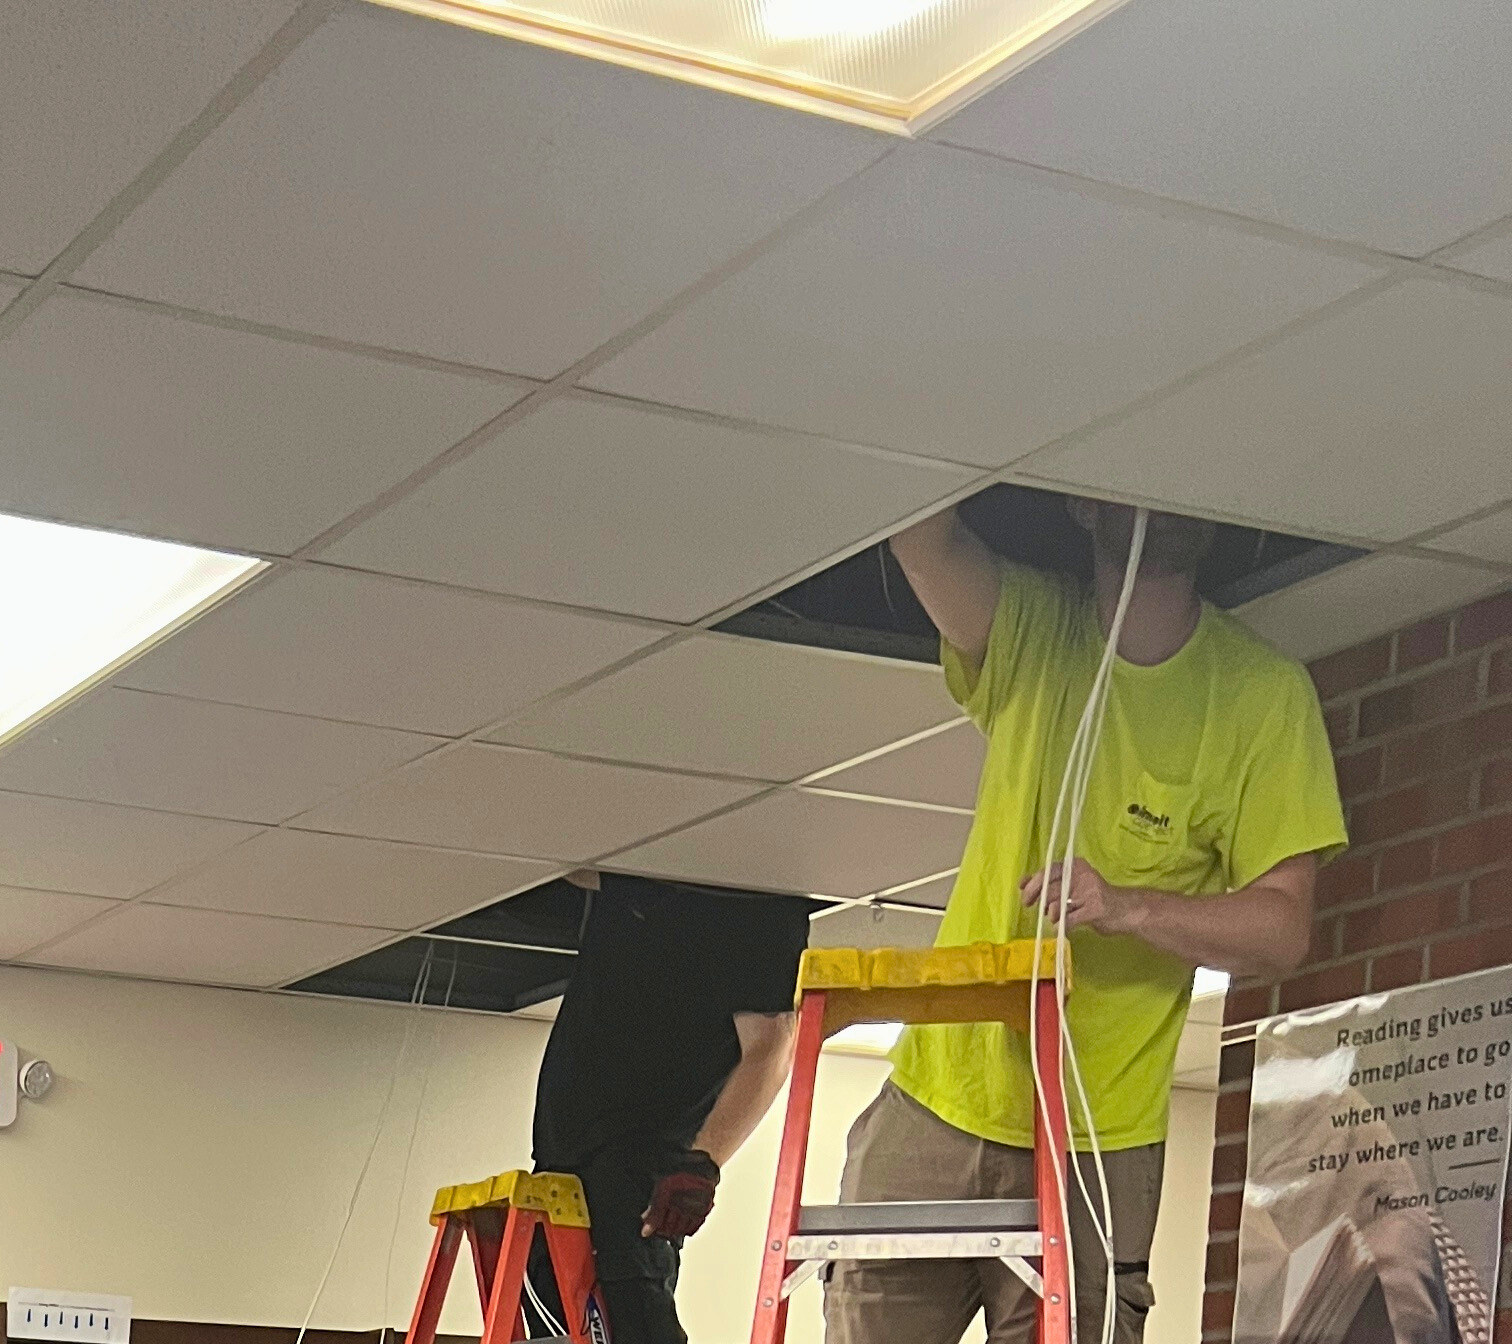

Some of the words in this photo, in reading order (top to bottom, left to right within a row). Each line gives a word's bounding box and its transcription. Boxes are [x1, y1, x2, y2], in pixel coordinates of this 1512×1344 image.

[1336, 1018, 1421, 1048] Reading
[1427, 1004, 1484, 1038] gives
[1348, 1053, 1450, 1088] omeplace
[1457, 1045, 1478, 1066] to
[1484, 1040, 1511, 1067] go
[1331, 1106, 1385, 1128] when
[1392, 1098, 1421, 1117] we
[1427, 1087, 1478, 1112] have
[1485, 1081, 1506, 1101] to
[1307, 1151, 1350, 1174] stay
[1356, 1140, 1420, 1164] where
[1426, 1133, 1456, 1152] we
[1462, 1126, 1503, 1149] are.
[1374, 1193, 1429, 1214] Mason
[1434, 1181, 1497, 1204] Cooley
